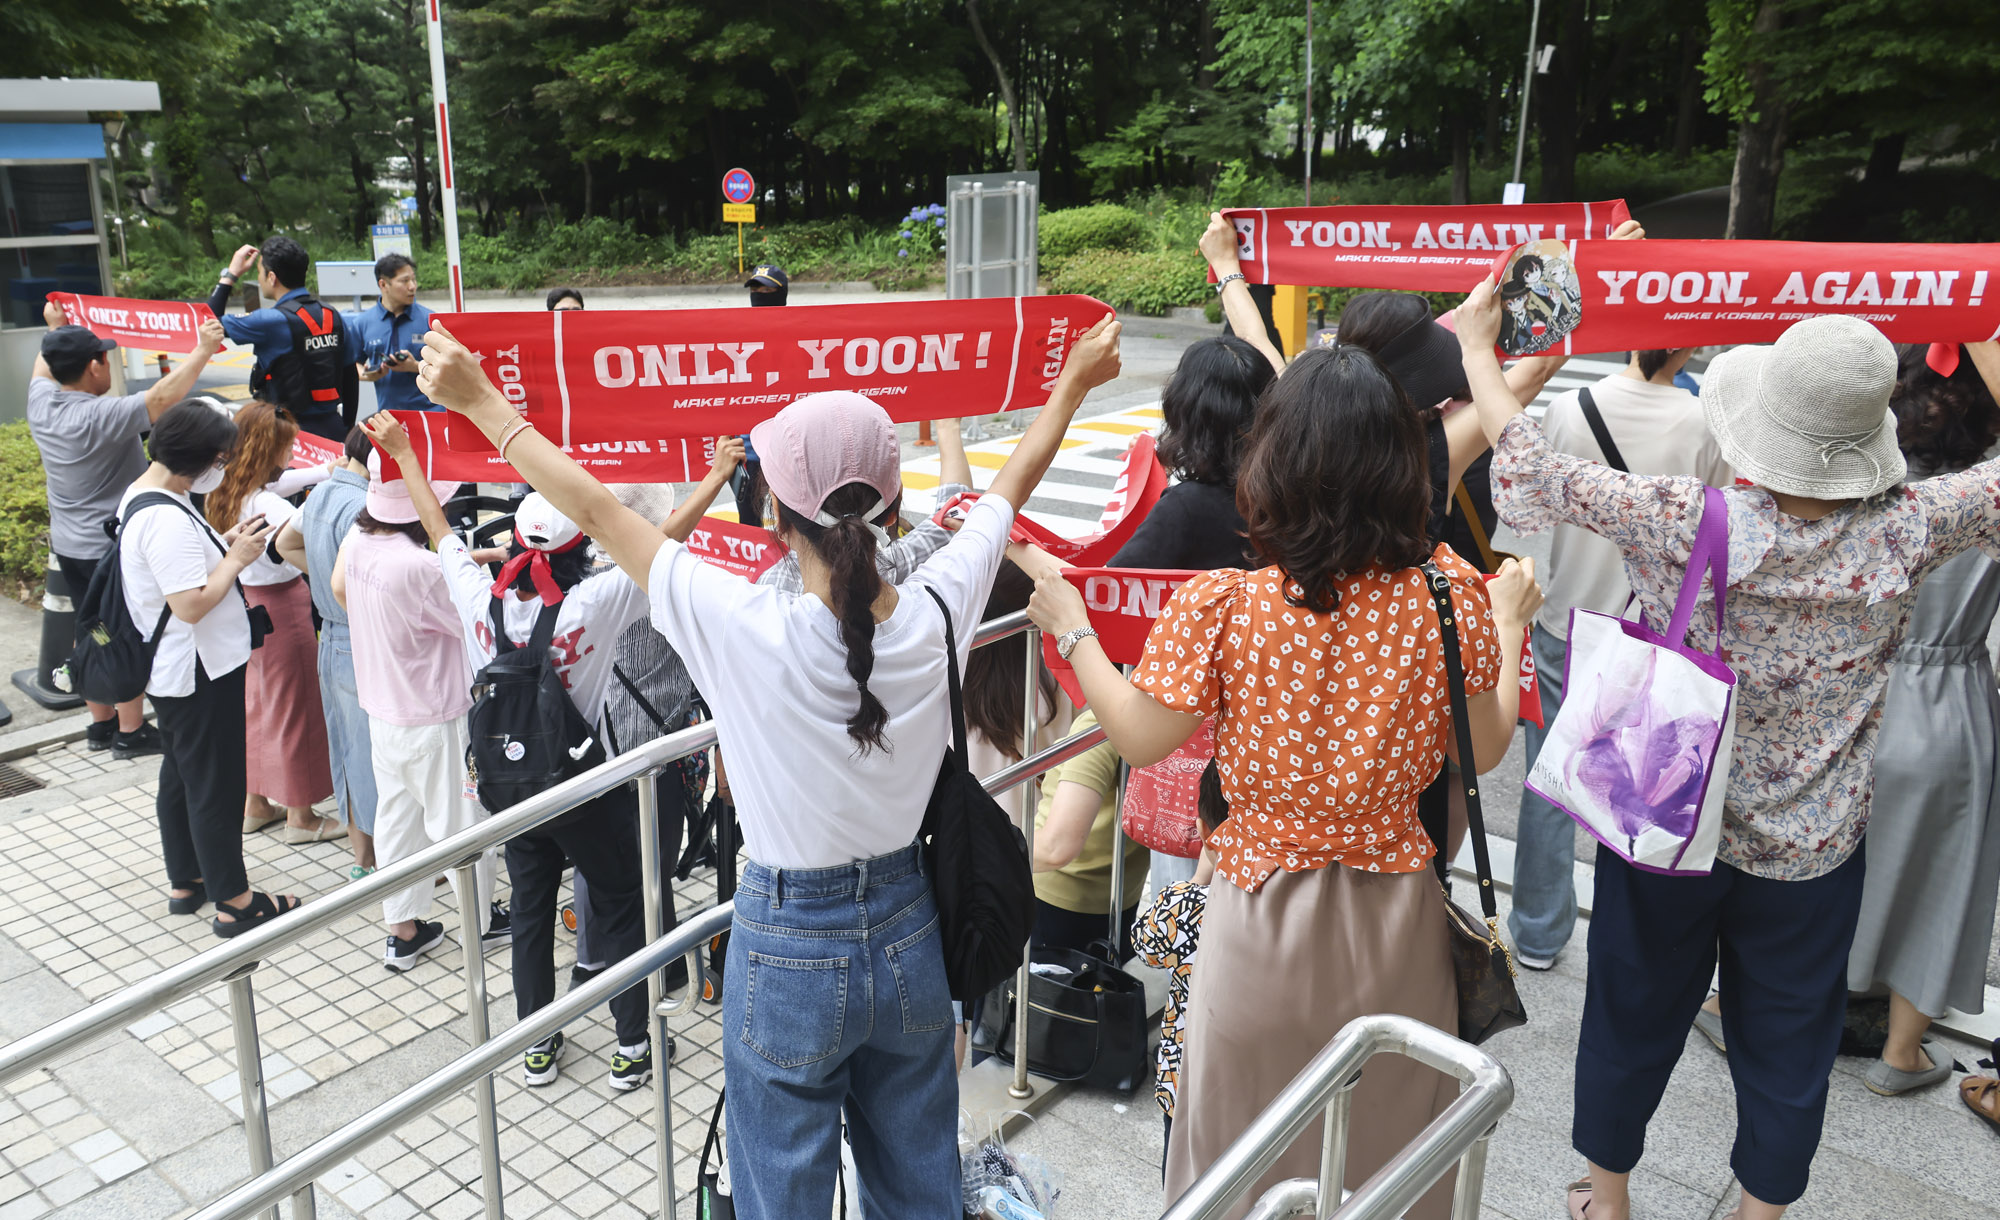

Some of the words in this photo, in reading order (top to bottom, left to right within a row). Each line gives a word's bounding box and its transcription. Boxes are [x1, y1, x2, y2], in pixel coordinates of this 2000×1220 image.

[1284, 220, 1401, 251] YOON,
[1373, 255, 1417, 263] KOREA
[1465, 257, 1495, 265] AGA
[1597, 271, 1758, 307] YOON,
[89, 306, 135, 330] ONLY,
[1663, 312, 1713, 320] MAKE
[1715, 312, 1775, 320] KOREA
[1778, 312, 1838, 320] GRE
[305, 334, 338, 350] POLICE
[593, 341, 779, 388] ONLY,
[673, 397, 726, 409] MAKE
[729, 394, 791, 406] KOREA
[702, 436, 715, 467] AGAI
[1085, 576, 1185, 618] ON
